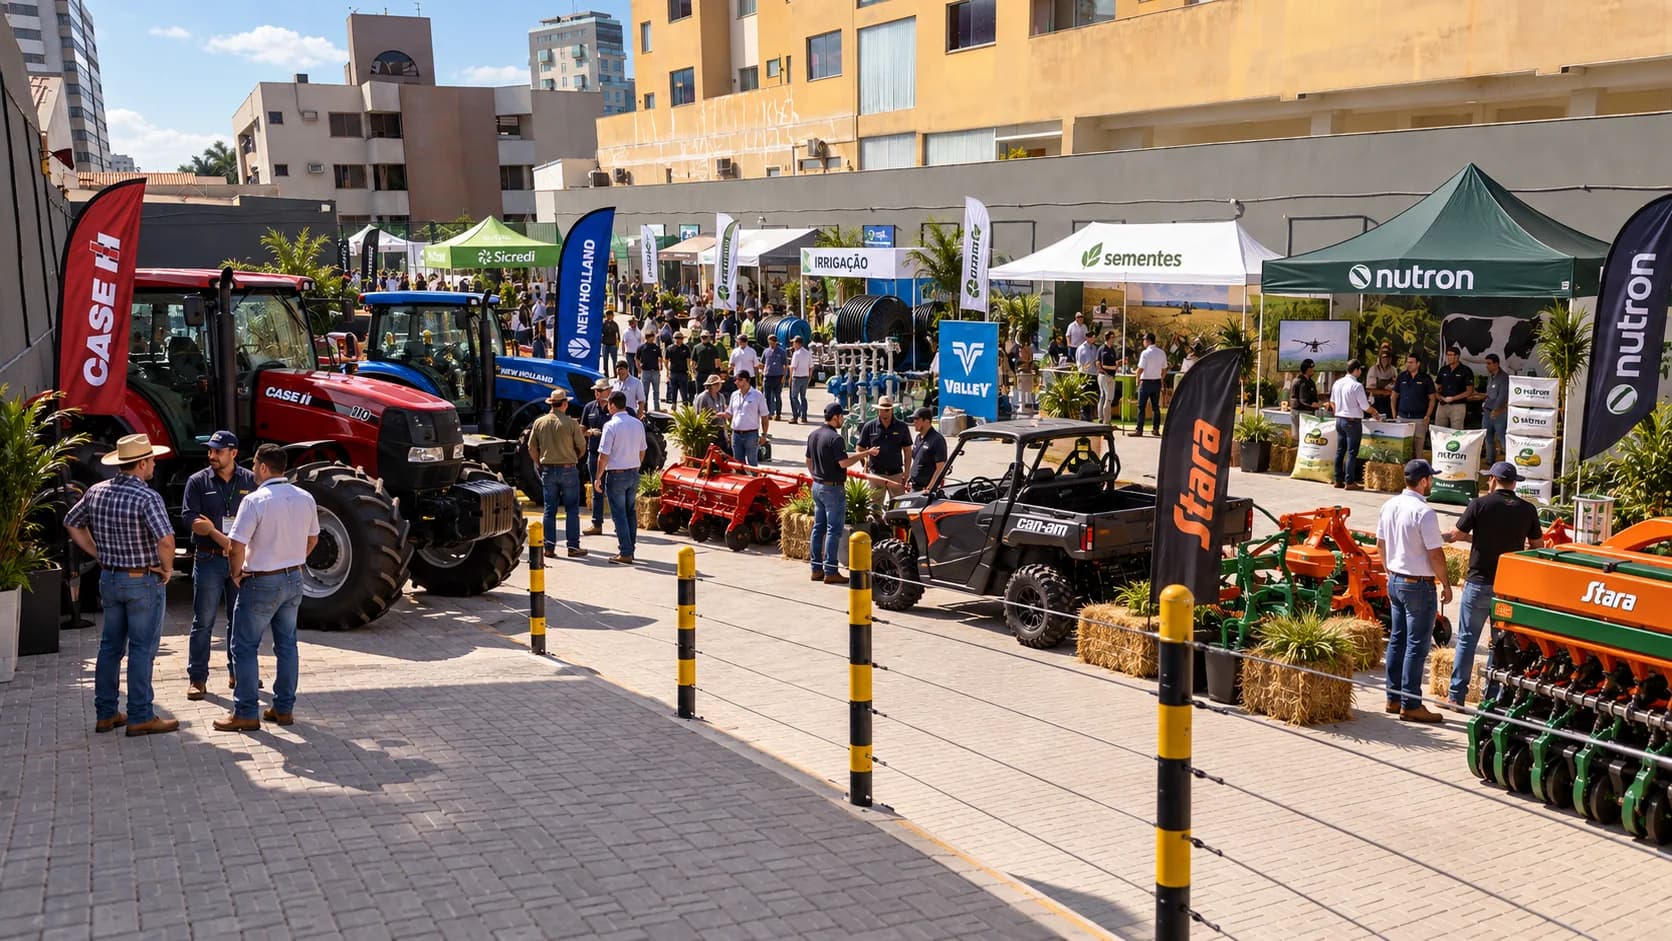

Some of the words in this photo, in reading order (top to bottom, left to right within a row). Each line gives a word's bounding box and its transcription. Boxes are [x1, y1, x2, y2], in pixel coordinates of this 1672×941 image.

[494, 250, 535, 263] Sicredi
[814, 253, 868, 273] IRRIGAÇÃO
[1104, 250, 1182, 267] sementes
[579, 239, 595, 302] HOLLAND
[1375, 265, 1474, 290] nutron
[576, 303, 589, 334] NEW
[1616, 252, 1657, 378] nutron
[83, 278, 117, 387] CASE
[500, 367, 518, 376] NEW
[265, 386, 300, 404] CASE
[943, 379, 992, 398] VALLEY
[1173, 418, 1221, 551] Stara
[1016, 518, 1069, 537] can-am
[1580, 581, 1637, 611] Stara
